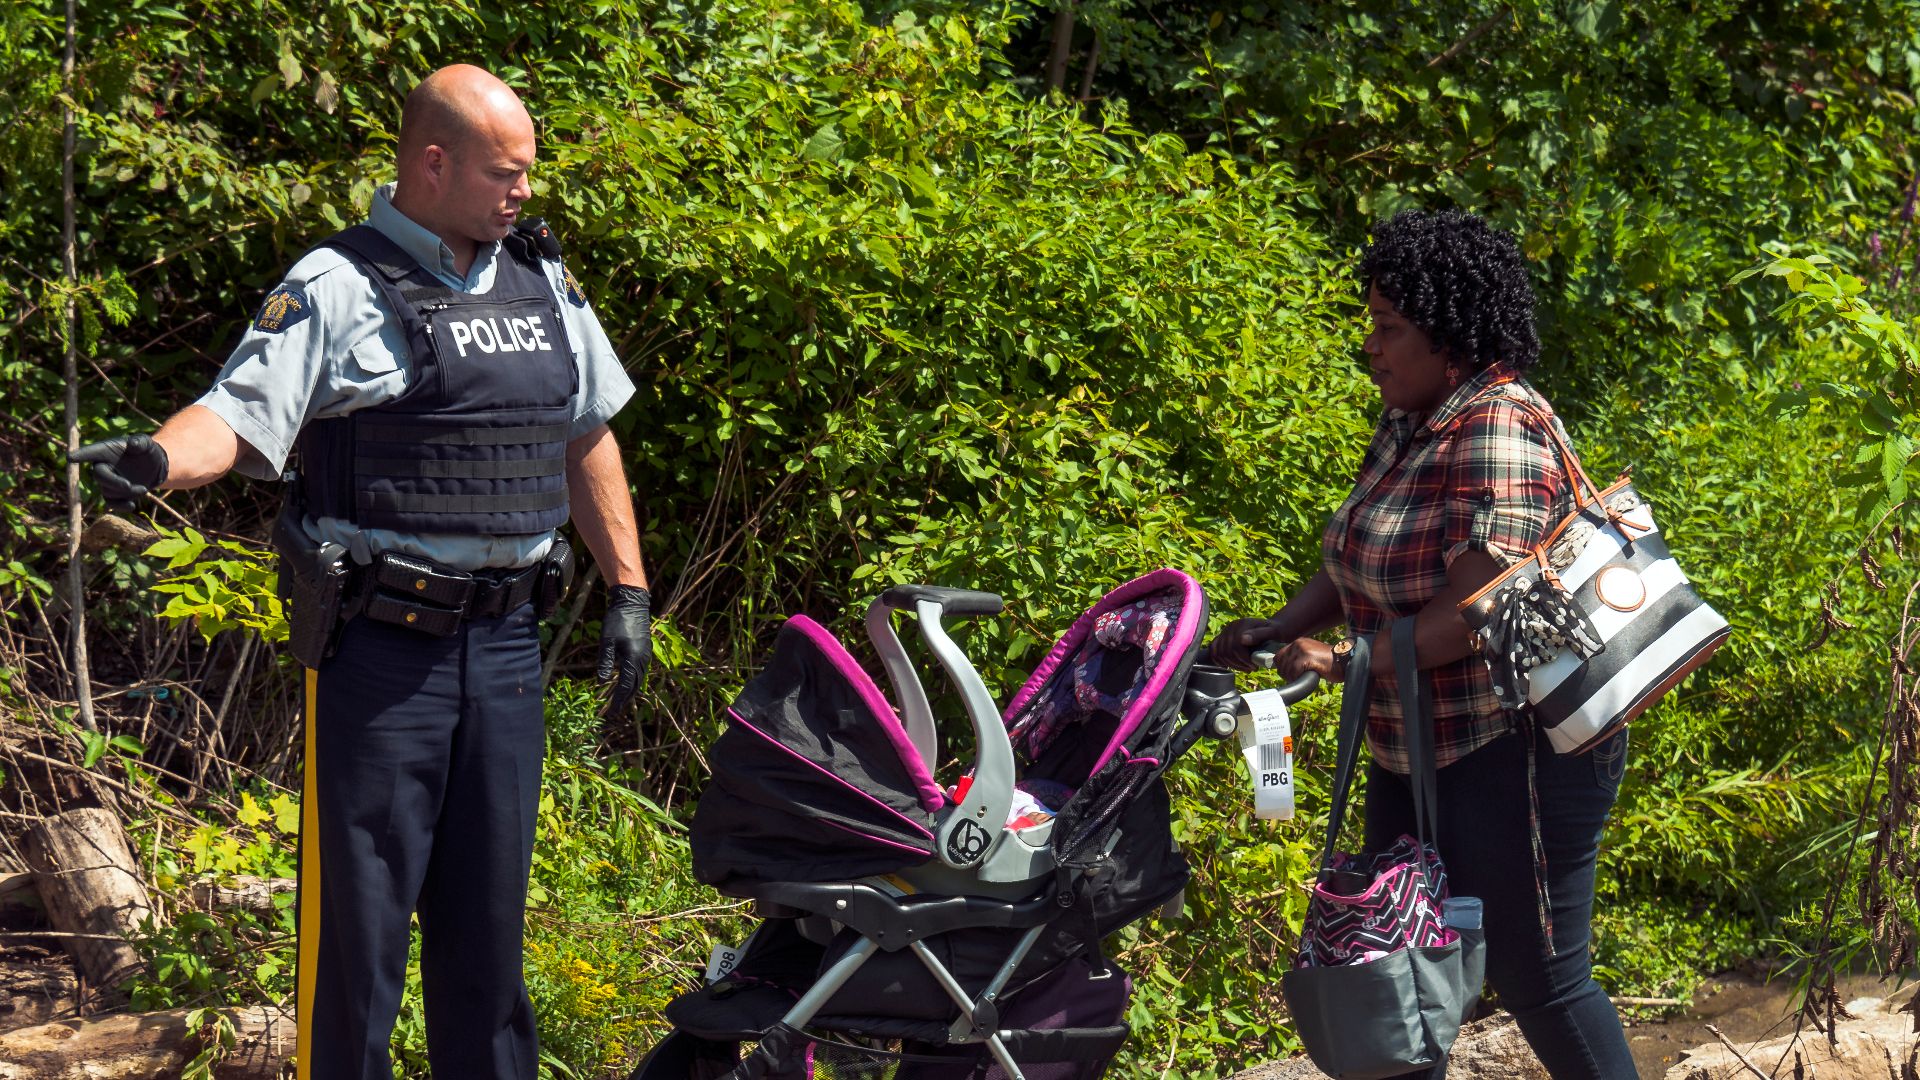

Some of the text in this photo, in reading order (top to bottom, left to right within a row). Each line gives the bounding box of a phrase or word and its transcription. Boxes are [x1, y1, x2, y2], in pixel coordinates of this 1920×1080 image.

[449, 316, 552, 357] POLICE
[1262, 771, 1289, 787] PBG
[716, 951, 736, 976] 798
